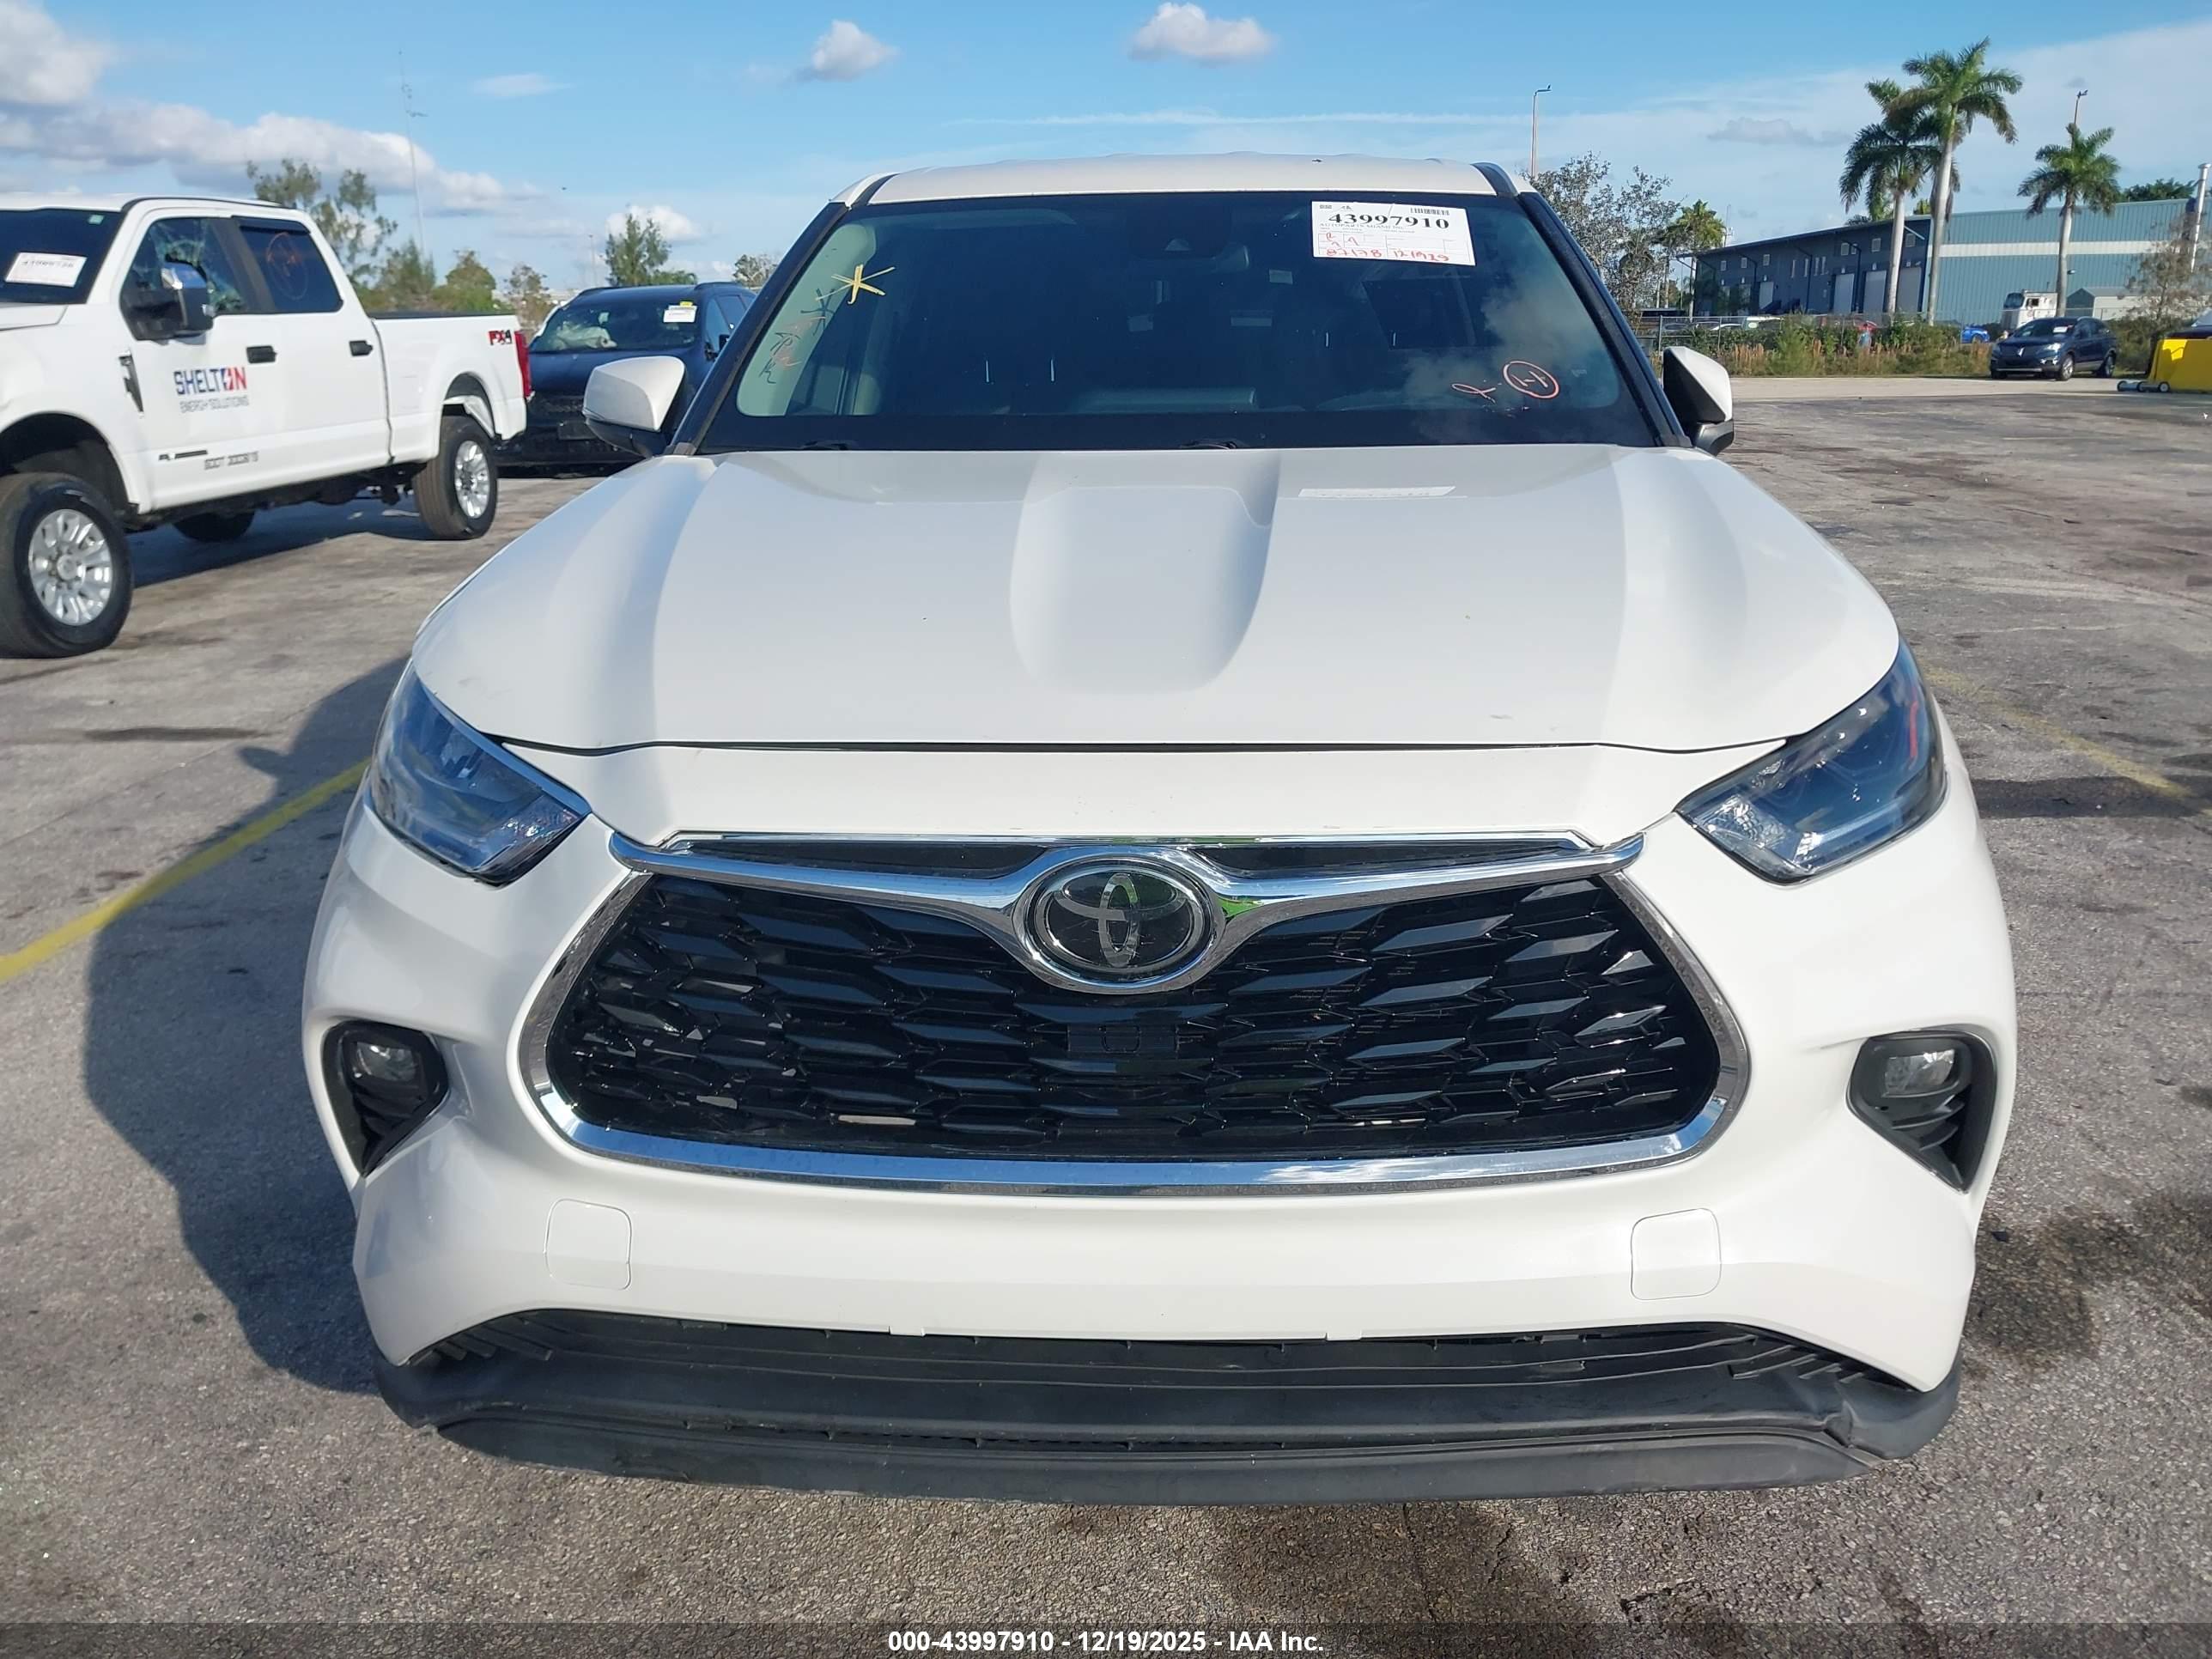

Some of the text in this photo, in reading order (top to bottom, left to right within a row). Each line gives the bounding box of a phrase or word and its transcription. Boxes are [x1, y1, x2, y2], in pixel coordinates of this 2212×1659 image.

[1328, 213, 1449, 229] 43997910
[488, 330, 513, 346] FX4
[173, 367, 247, 395] SHELTON
